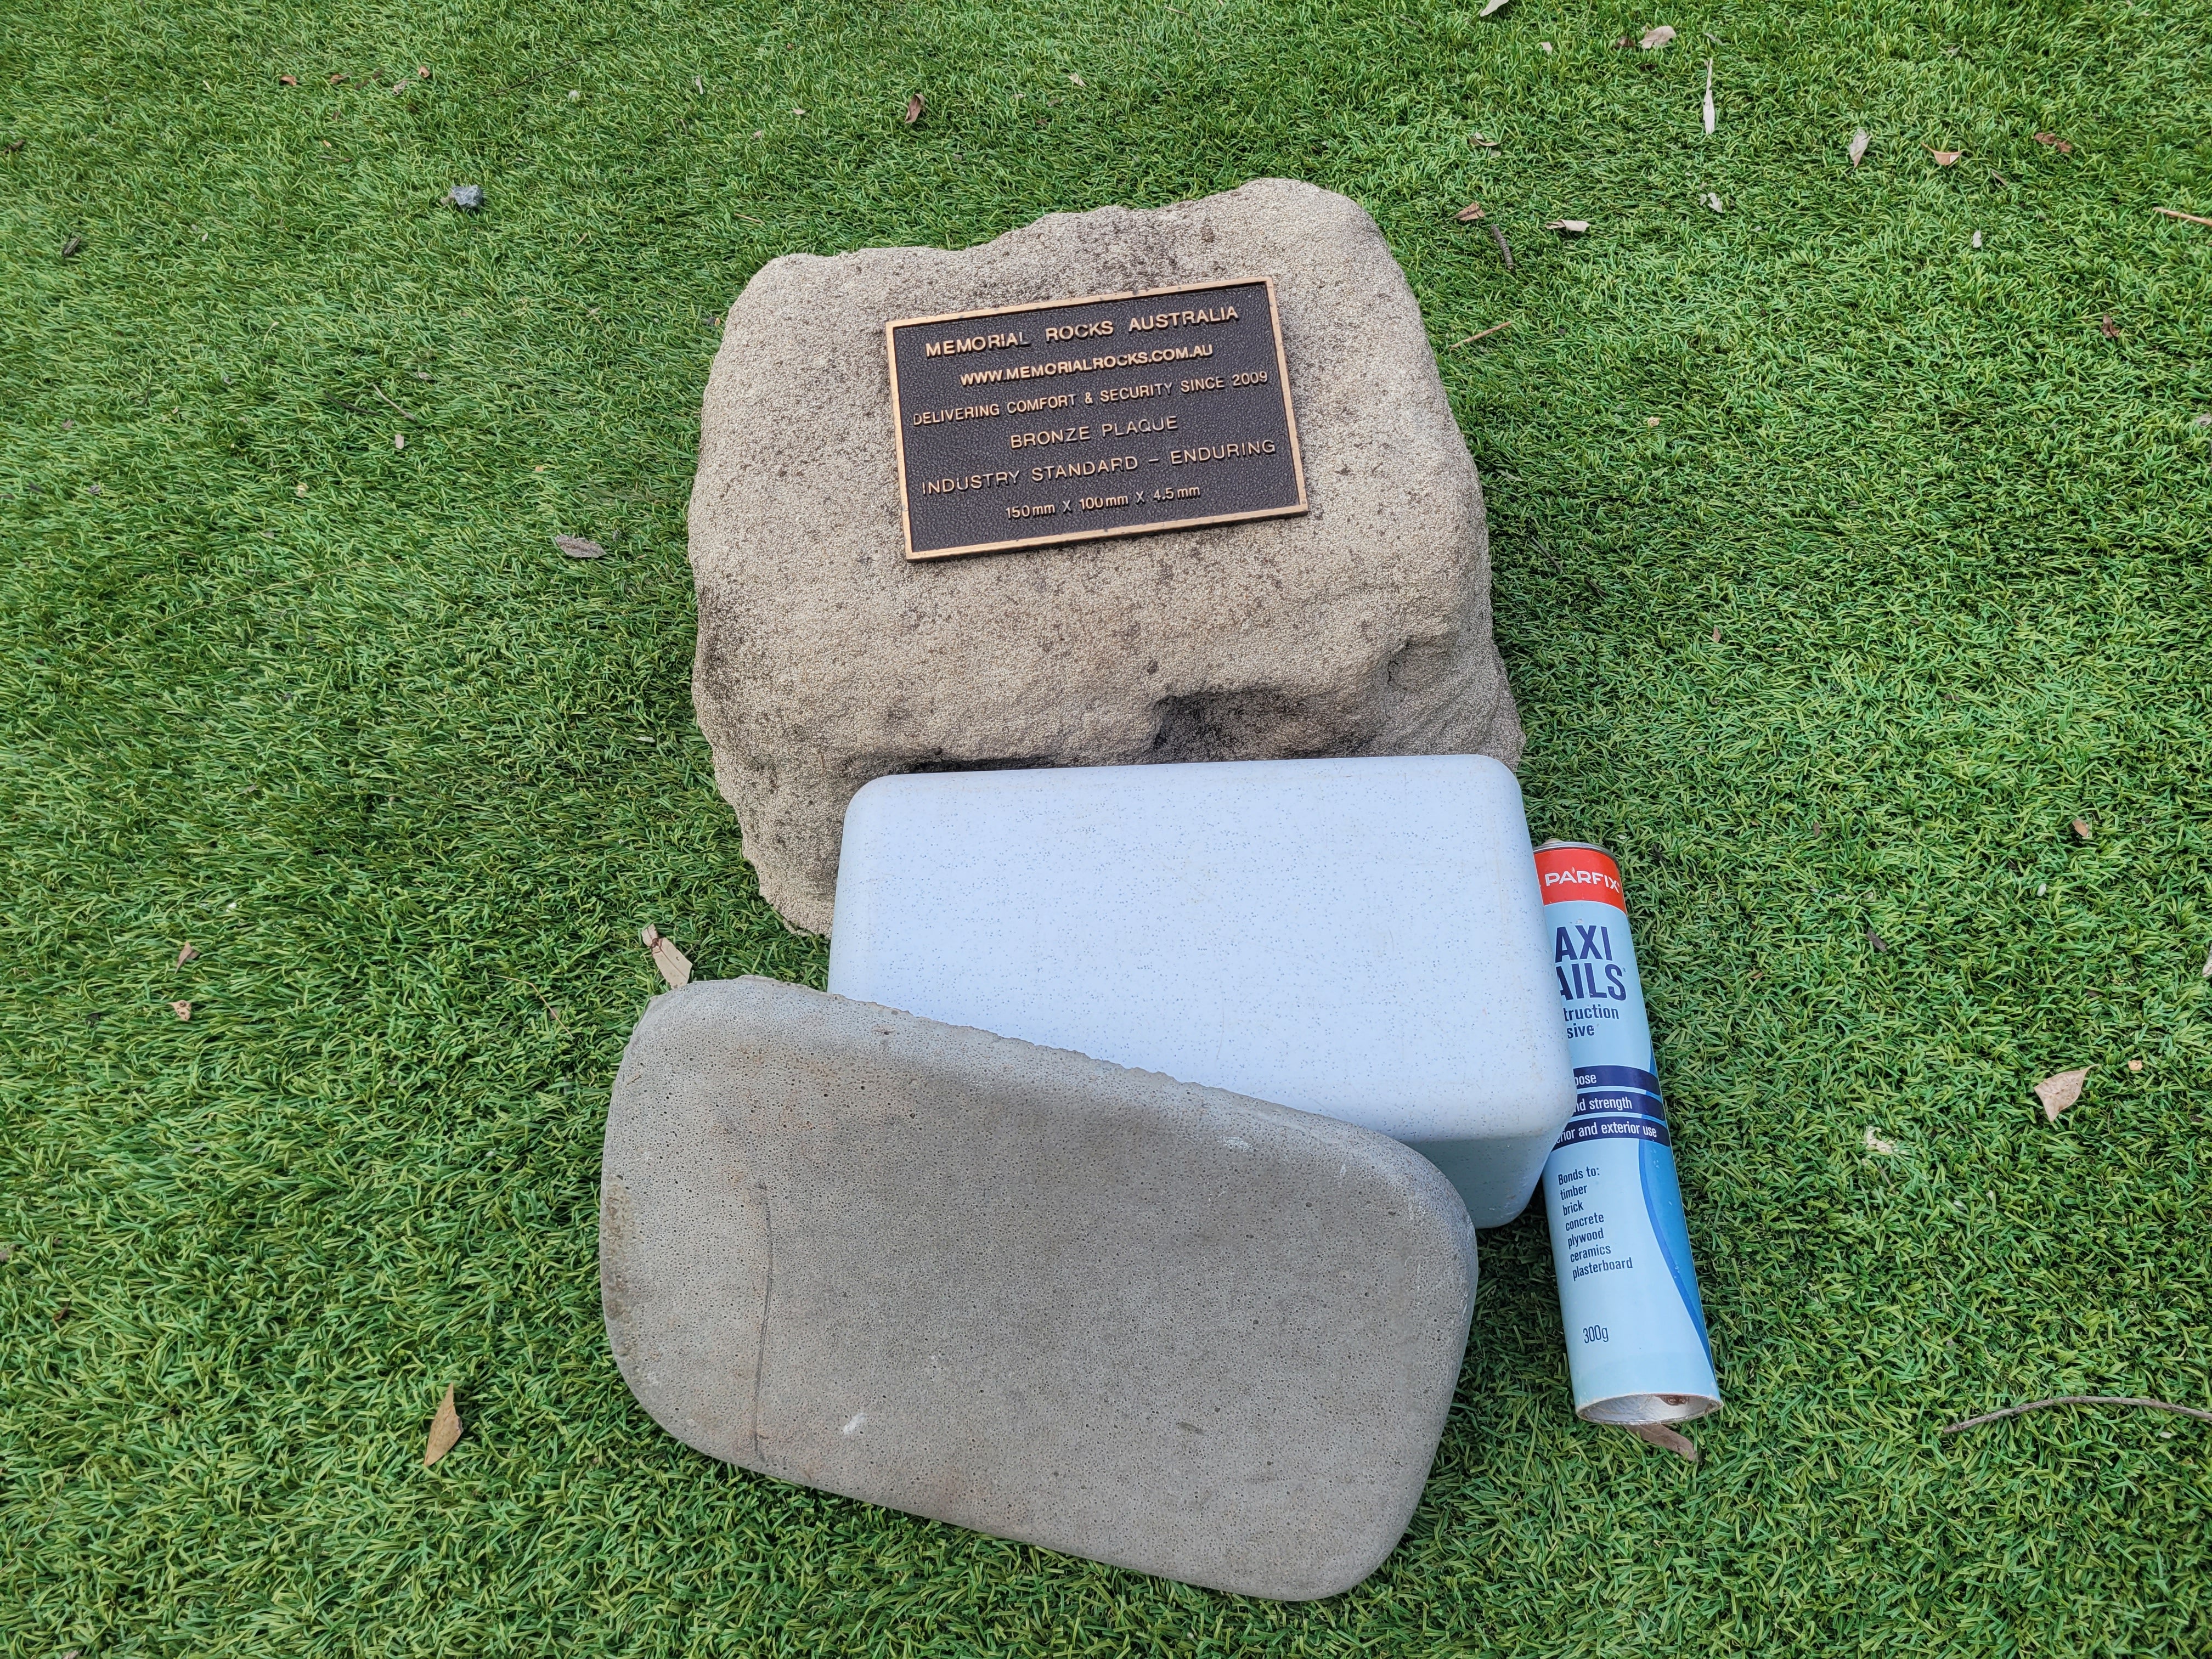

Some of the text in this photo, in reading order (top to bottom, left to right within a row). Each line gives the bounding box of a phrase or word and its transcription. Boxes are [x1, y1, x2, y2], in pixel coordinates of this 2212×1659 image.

[925, 306, 1239, 358] MEMORIAL ROCKS AUSTRALIA
[960, 343, 1214, 386] WWW.MEMORIALROCKS.COM.AU
[913, 371, 1268, 426] DELIVERING COMFORT & SECURITY SINCE 2009
[1010, 415, 1178, 449] BRONZE PLAQUE
[921, 470, 1020, 495] INDUSTRY
[1031, 456, 1139, 482] STANDARD
[1170, 439, 1276, 465] ENDURING
[1555, 925, 1613, 963] AXI
[1555, 962, 1627, 1001] AILS
[1563, 1003, 1620, 1022] truction
[1566, 1023, 1595, 1040] sive
[1589, 1096, 1633, 1111] strength
[1578, 1121, 1599, 1137] and
[1601, 1120, 1641, 1135] exterior
[1642, 1126, 1658, 1138] use
[1558, 1166, 1600, 1186] Bonds to:
[1560, 1184, 1588, 1201] timber
[1562, 1200, 1584, 1216] brick
[1565, 1212, 1605, 1232] concrete
[1567, 1227, 1605, 1250] plywood
[1570, 1244, 1612, 1263] ceramics
[1572, 1256, 1633, 1282] plasterboard
[1583, 1324, 1609, 1343] 300g
